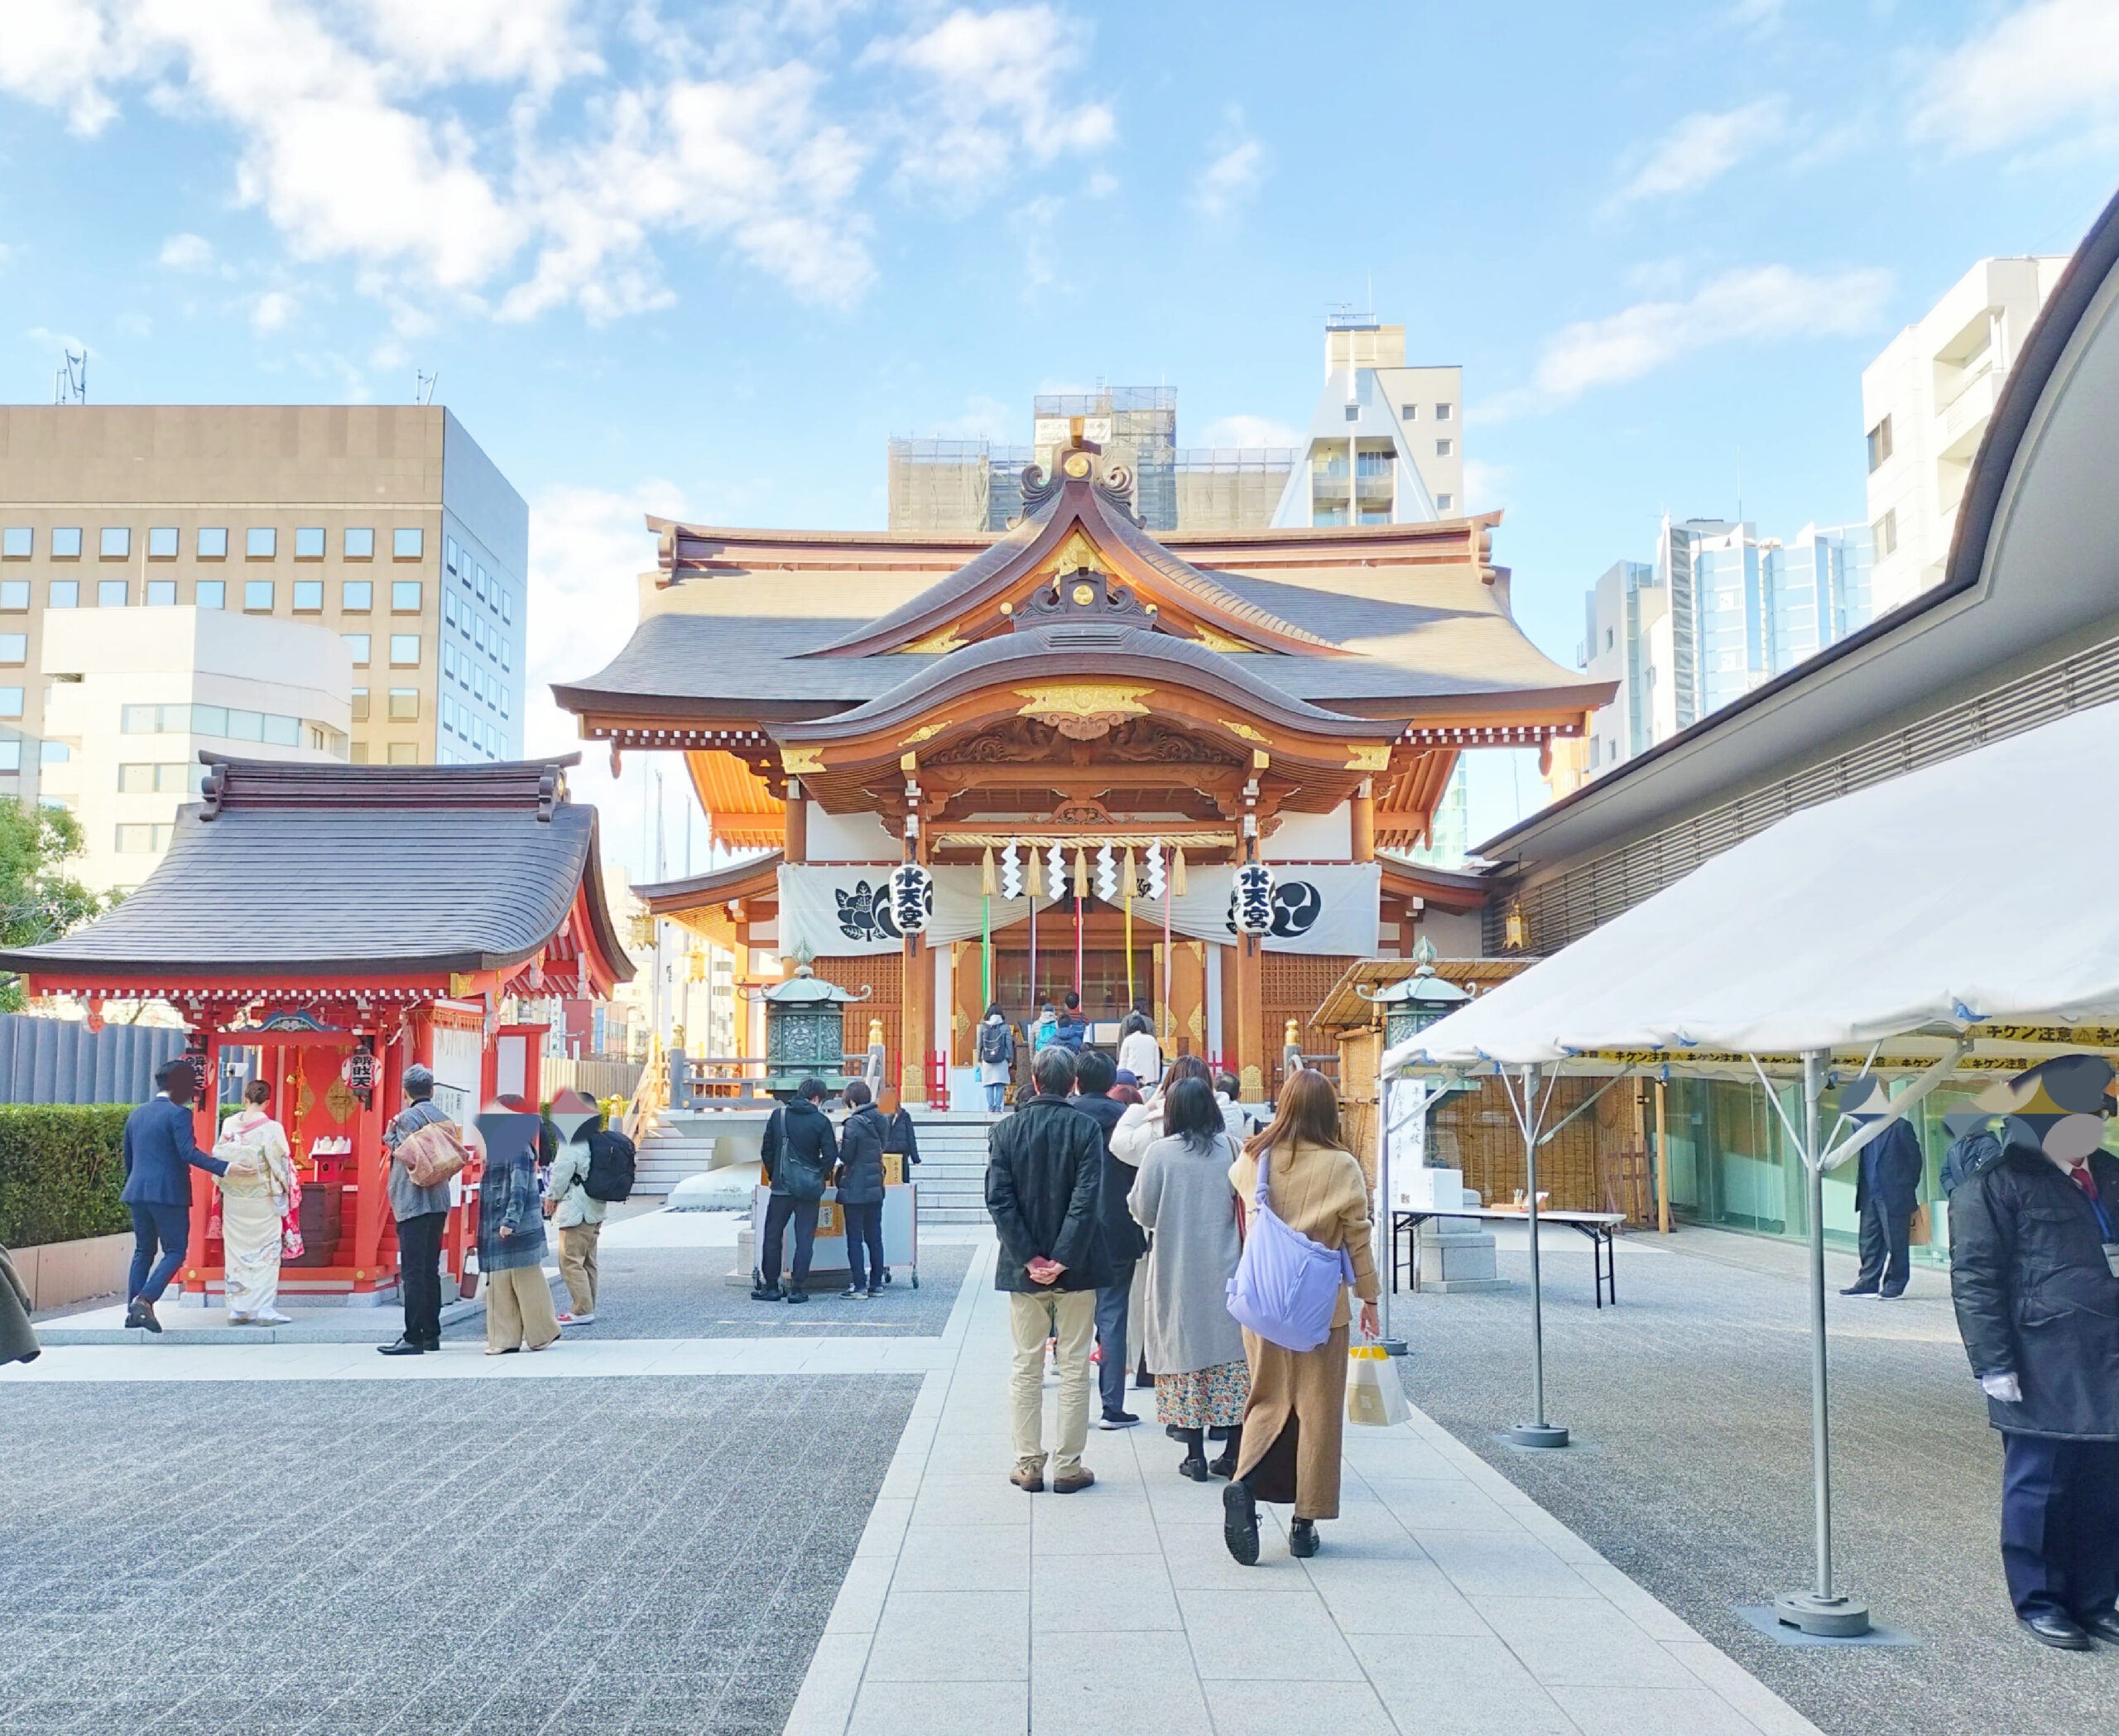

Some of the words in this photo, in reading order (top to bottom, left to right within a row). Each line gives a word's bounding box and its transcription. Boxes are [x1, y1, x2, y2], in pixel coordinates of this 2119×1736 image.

[896, 867, 924, 929] 水天宮
[1241, 867, 1269, 929] 水天宮
[1987, 1025, 2073, 1042] キケン注意
[1972, 1058, 2028, 1069] キケン注意
